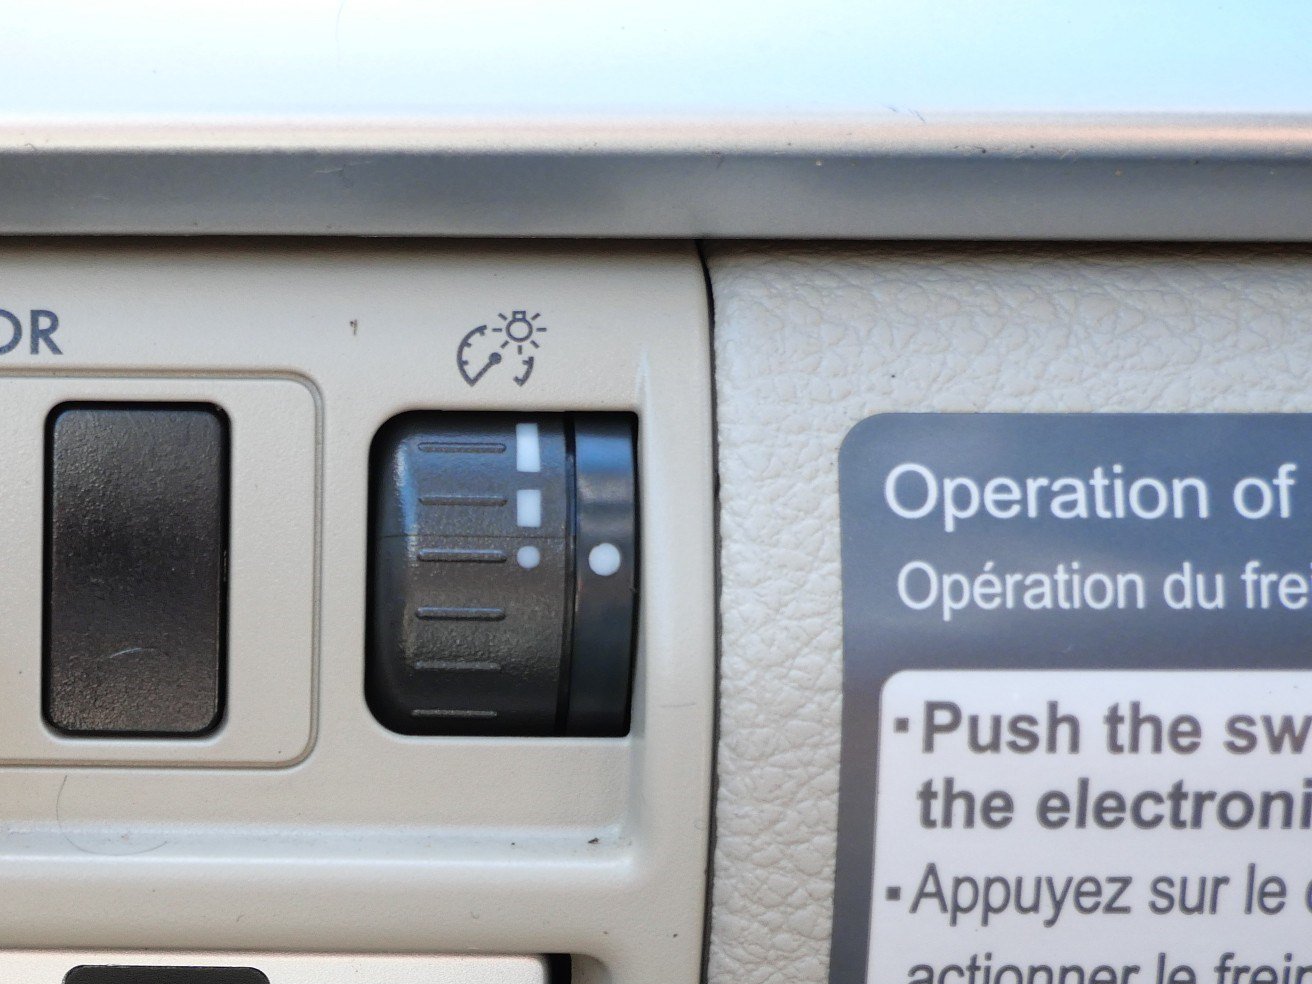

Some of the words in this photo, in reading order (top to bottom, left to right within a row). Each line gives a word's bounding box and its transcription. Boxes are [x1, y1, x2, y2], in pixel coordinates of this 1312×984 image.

[883, 461, 1209, 533] Operation
[1232, 462, 1297, 520] of
[896, 559, 1146, 622] Opération
[1162, 561, 1225, 610] du
[1240, 559, 1312, 610] fre
[922, 700, 1081, 755] Push
[1103, 700, 1203, 756] the
[1224, 714, 1312, 756] sw
[916, 776, 1015, 830] the
[1036, 777, 1312, 831] electroni
[909, 862, 1133, 929] Appuyez
[1148, 875, 1231, 916] sur
[1244, 862, 1288, 916] le
